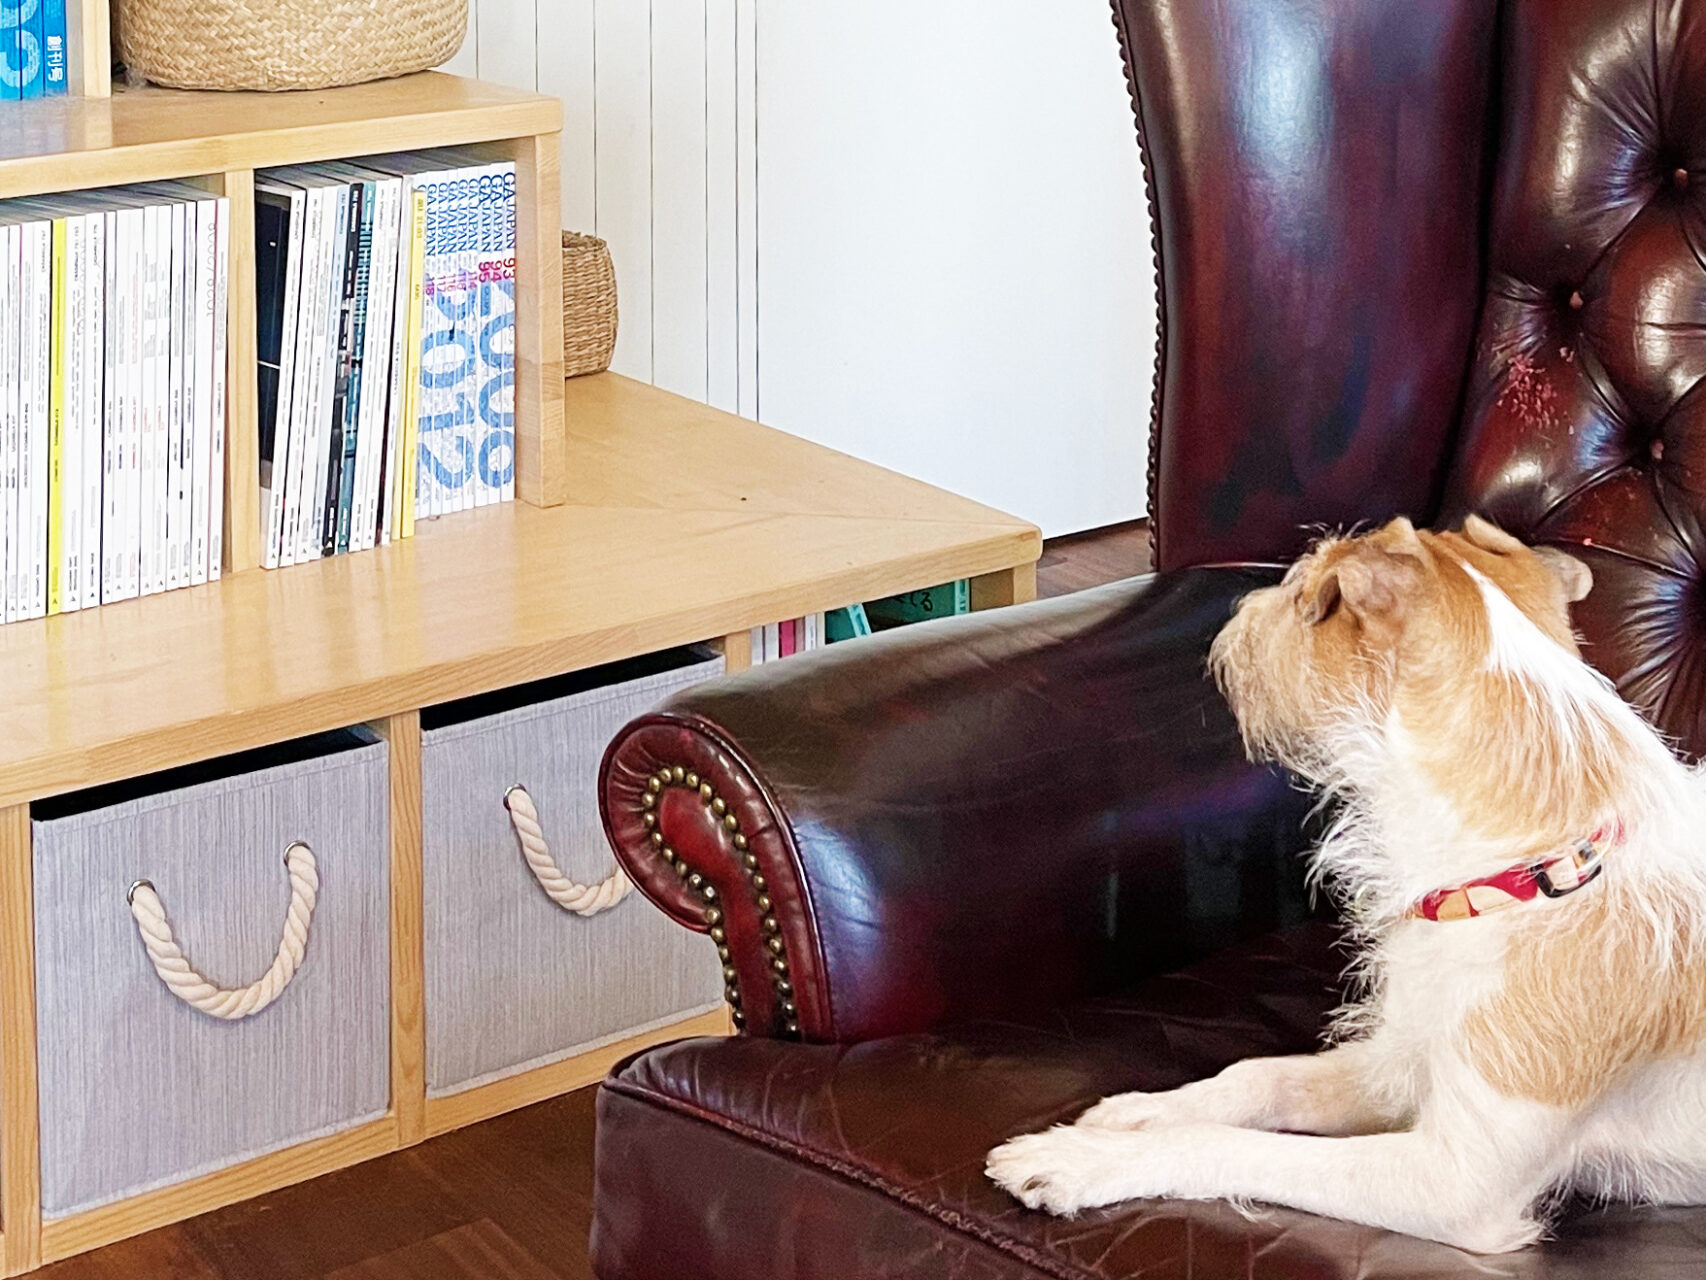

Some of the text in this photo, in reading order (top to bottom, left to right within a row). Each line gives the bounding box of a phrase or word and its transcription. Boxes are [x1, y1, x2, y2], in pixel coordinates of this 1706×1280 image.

[426, 208, 436, 256] JAPAN
[438, 206, 447, 255] JAPAN
[448, 205, 457, 253] JAPAN
[458, 203, 467, 251] JAPAN
[468, 203, 478, 250] JAPAN
[482, 203, 491, 252] JAPAN
[493, 203, 503, 252] JAPAN
[506, 200, 516, 249] JAPAN
[478, 261, 490, 283] 95
[490, 260, 503, 282] 94
[503, 258, 516, 279] 93
